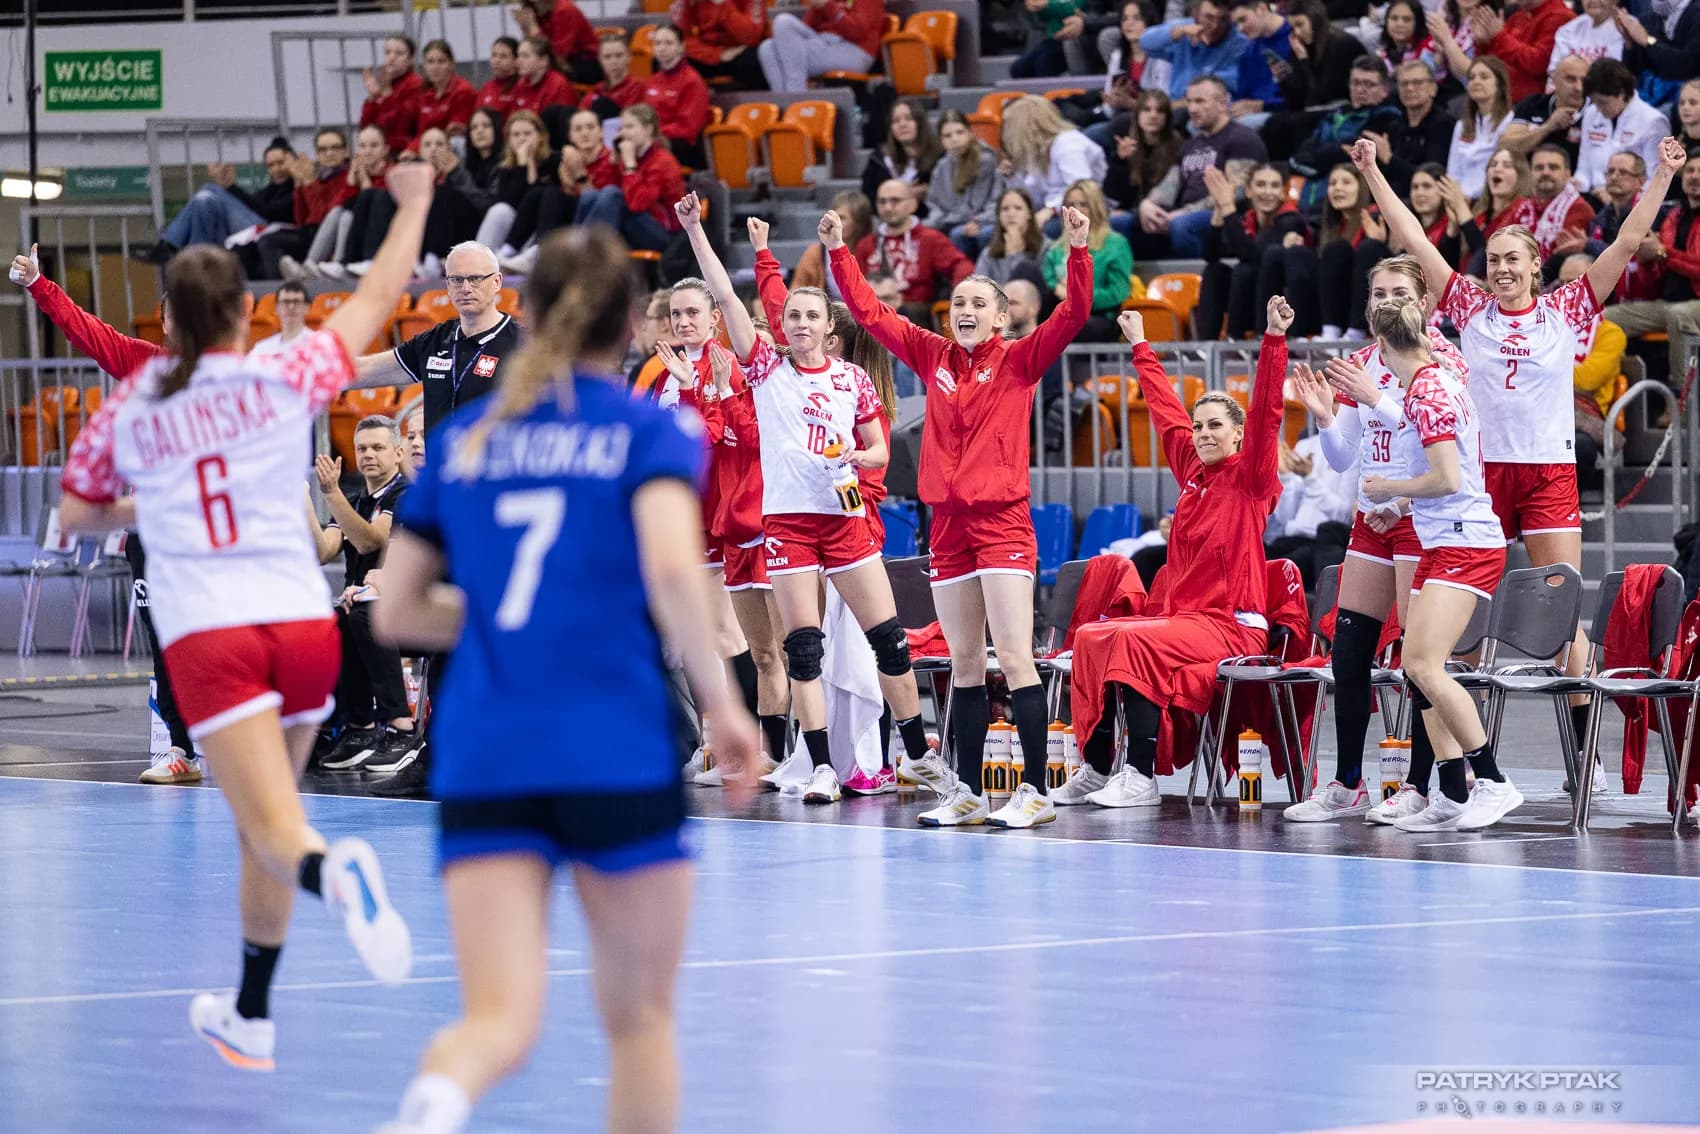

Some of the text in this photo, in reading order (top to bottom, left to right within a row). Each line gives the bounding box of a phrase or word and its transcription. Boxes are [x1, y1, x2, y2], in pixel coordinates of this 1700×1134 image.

[54, 56, 155, 82] WYJŚCIE
[48, 84, 160, 103] EWAKUACYJNE
[1500, 346, 1530, 357] ORLEN
[1505, 359, 1518, 390] 2
[802, 406, 833, 422] ORLEN
[807, 423, 827, 455] 18
[1372, 430, 1392, 462] 39
[195, 453, 240, 550] 6
[494, 486, 567, 632] 7
